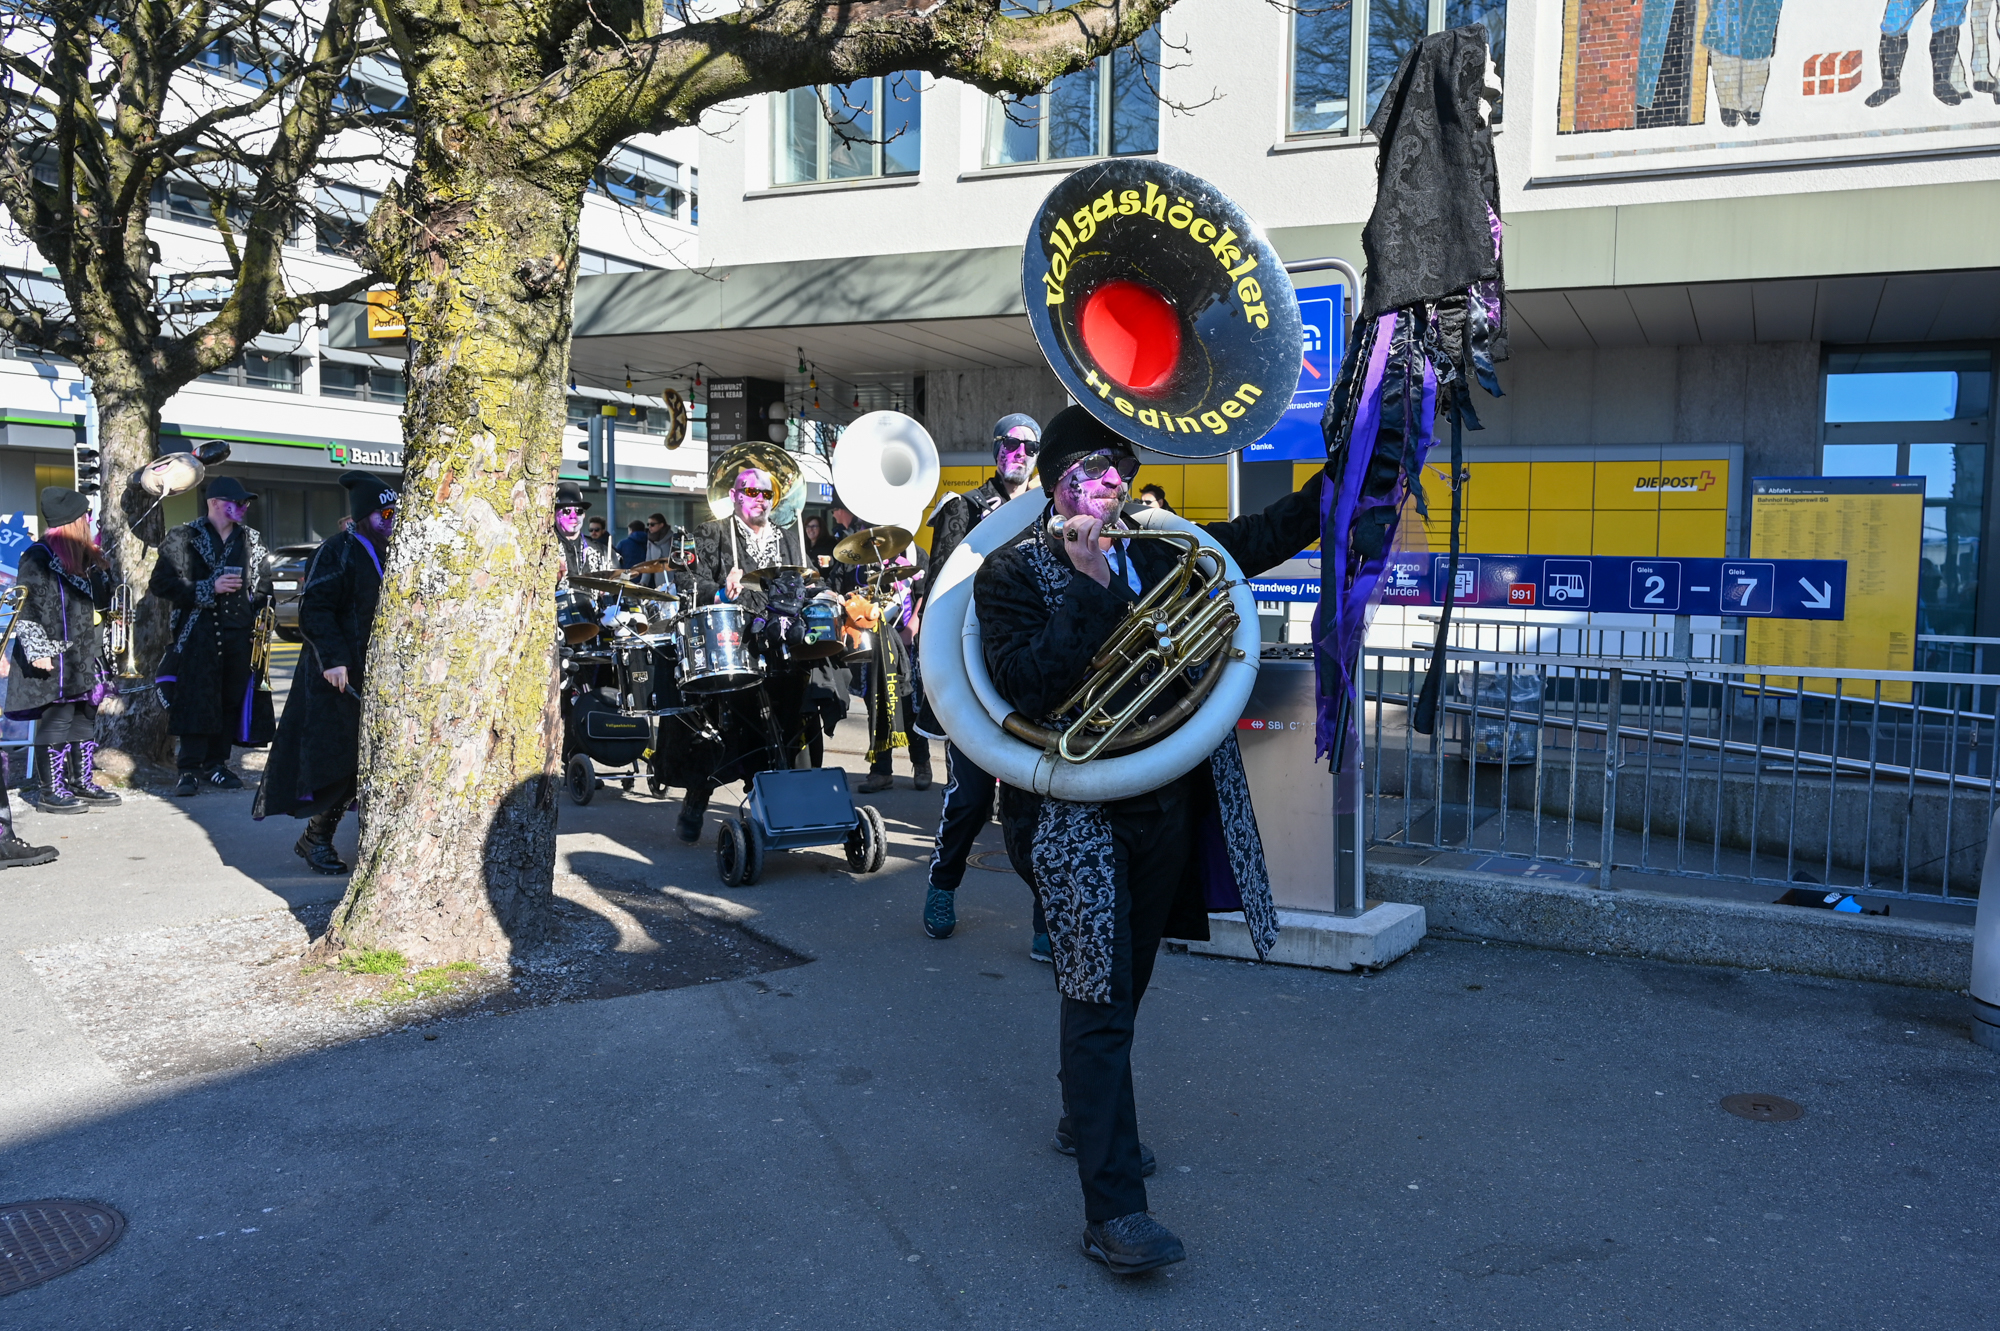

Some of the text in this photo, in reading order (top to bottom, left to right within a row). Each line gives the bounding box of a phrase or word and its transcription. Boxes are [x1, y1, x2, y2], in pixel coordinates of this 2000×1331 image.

[1042, 180, 1269, 330] Vollgashöckler
[725, 391, 743, 399] KEBAB
[1085, 369, 1263, 435] Hedingen
[1250, 443, 1275, 451] Danke.
[351, 448, 391, 466] Bank
[942, 479, 979, 487] Versenden
[1635, 477, 1699, 488] DIE POST
[1637, 566, 1654, 574] Gleis
[1728, 568, 1746, 576] Gleis
[1249, 582, 1297, 595] trandweg
[1643, 575, 1666, 604] 2
[1737, 578, 1758, 607] 7
[1511, 589, 1532, 600] 991
